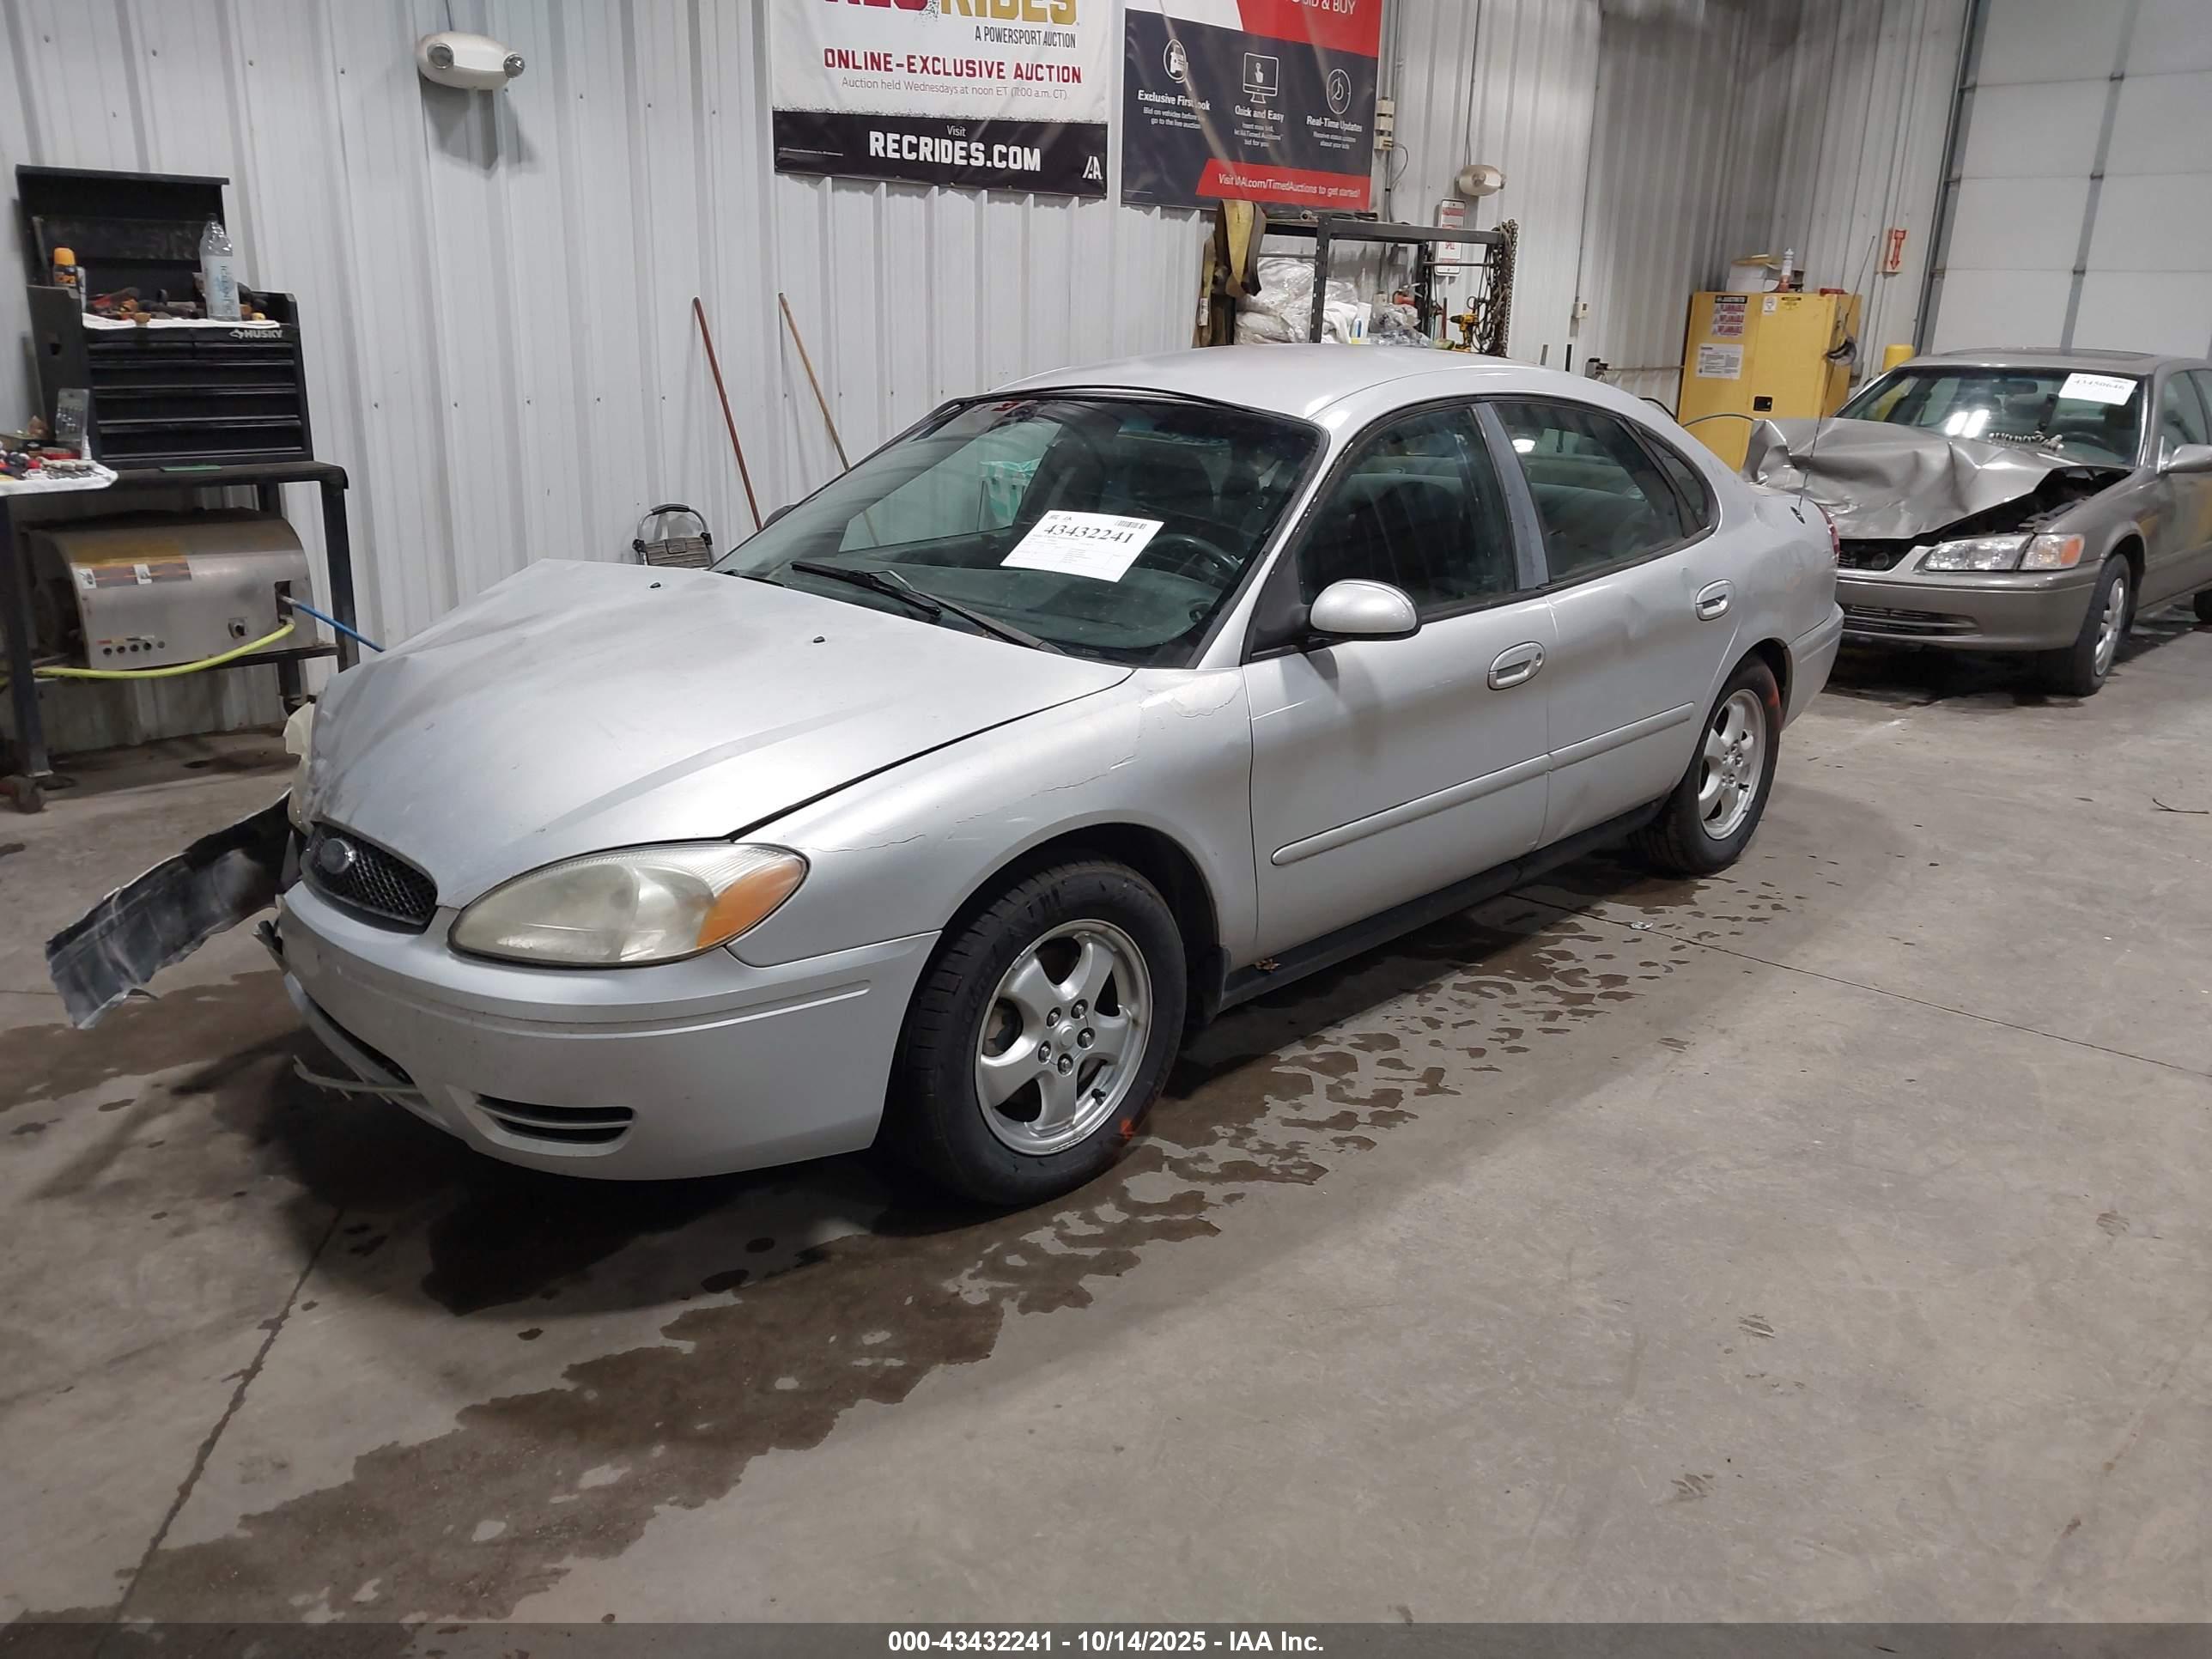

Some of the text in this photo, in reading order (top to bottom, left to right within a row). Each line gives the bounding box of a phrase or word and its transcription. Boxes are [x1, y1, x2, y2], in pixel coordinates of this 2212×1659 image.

[1333, 0, 1356, 15] BUY
[975, 26, 1076, 48] A POWERSPORT AUCTION
[824, 48, 1082, 83] ONLINE-EXCLUSIVE AUCTION
[842, 77, 878, 89] Auction
[881, 81, 901, 90] held
[903, 81, 958, 94] Wednesdays
[960, 85, 969, 94] at
[971, 87, 994, 96] noon
[996, 86, 1008, 96] ET
[1138, 89, 1176, 105] Exclusive
[1235, 105, 1284, 123] Quick and Easy
[1306, 115, 1340, 128] Real-Time
[947, 125, 966, 137] Visit
[869, 131, 1041, 171] RECRIDES.COM
[1218, 173, 1233, 185] Visit
[1318, 185, 1327, 195] to
[1328, 187, 1339, 198] get
[244, 329, 283, 339] HUSKY
[1044, 524, 1133, 544] 43432241
